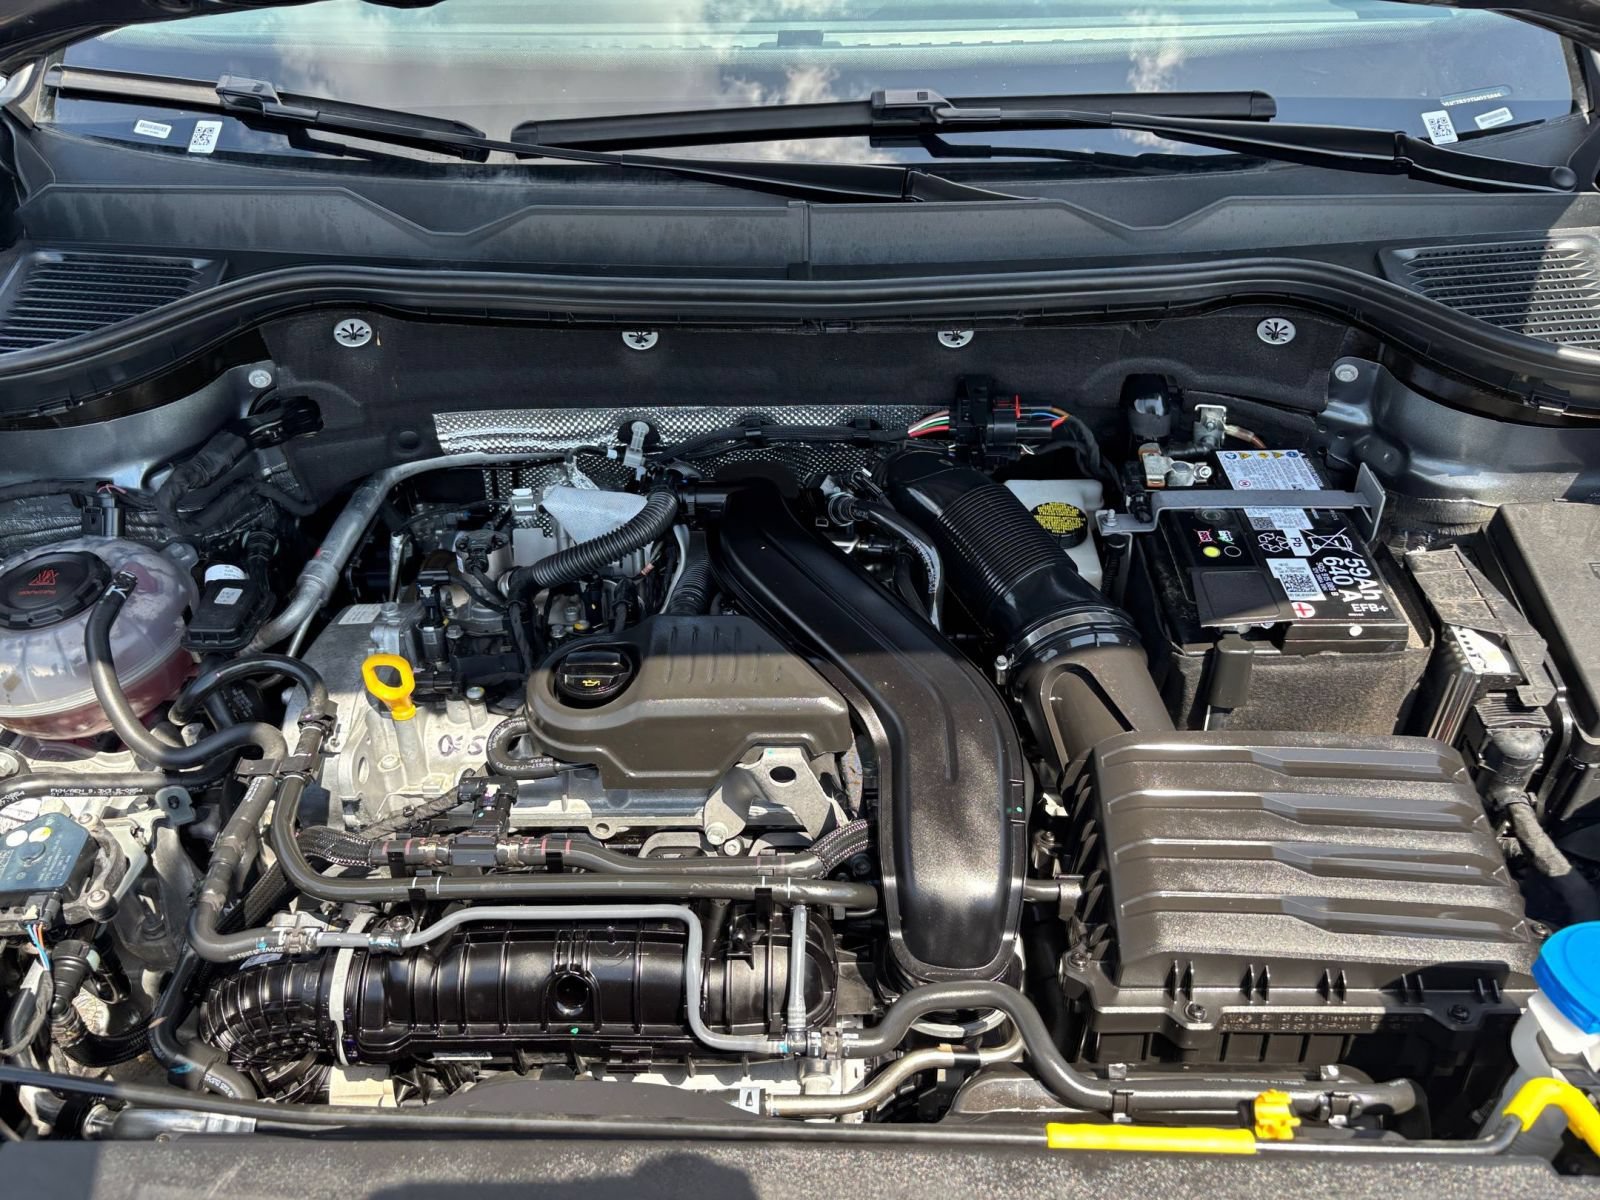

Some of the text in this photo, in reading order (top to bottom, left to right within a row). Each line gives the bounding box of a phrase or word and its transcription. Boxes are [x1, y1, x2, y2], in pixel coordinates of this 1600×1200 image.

[1290, 536, 1302, 548] Pb
[1322, 556, 1354, 586] 640
[1338, 588, 1363, 603] A
[1344, 557, 1383, 601] 59Ah
[1351, 603, 1389, 612] EFB+
